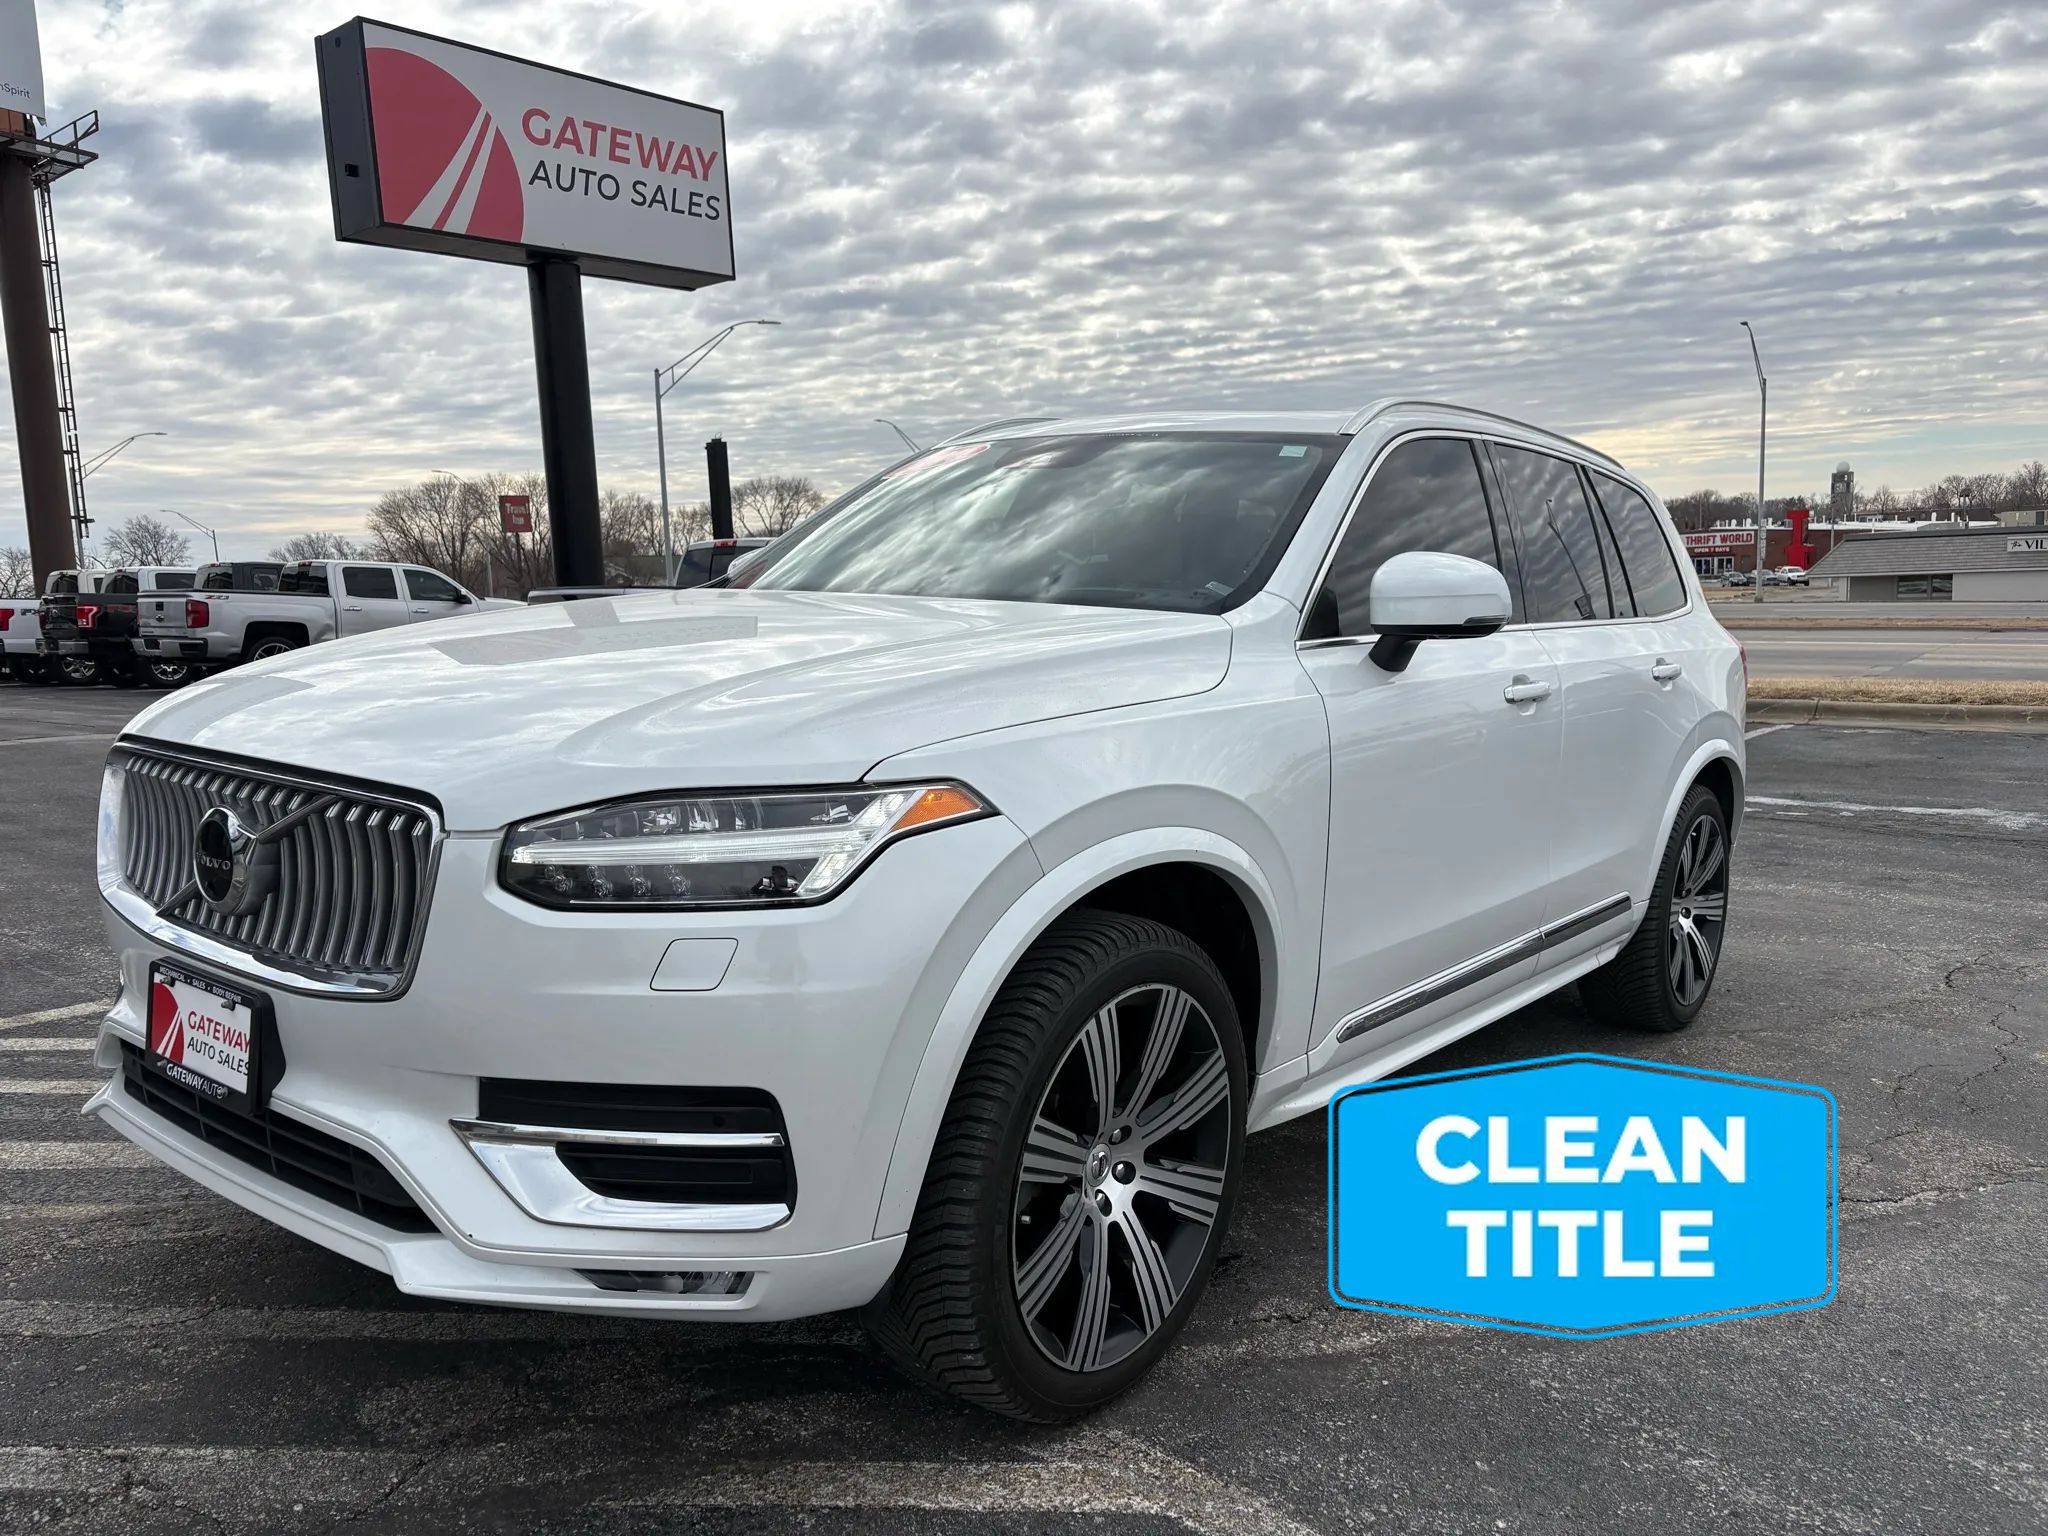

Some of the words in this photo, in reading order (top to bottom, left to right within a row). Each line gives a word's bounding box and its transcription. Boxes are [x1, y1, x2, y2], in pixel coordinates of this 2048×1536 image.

[521, 107, 718, 182] GATEWAY
[528, 159, 621, 201] AUTO
[630, 179, 721, 221] SALES
[1685, 534, 1717, 546] THRIFT
[1719, 532, 1753, 545] WORLD
[160, 965, 185, 982] MECHANICAL
[192, 978, 206, 990] SALES
[212, 986, 225, 998] BODY
[225, 991, 242, 1004] REPAIR
[188, 1010, 251, 1054] GATEWAY
[187, 1036, 216, 1060] AUTO
[217, 1049, 250, 1077] SALES
